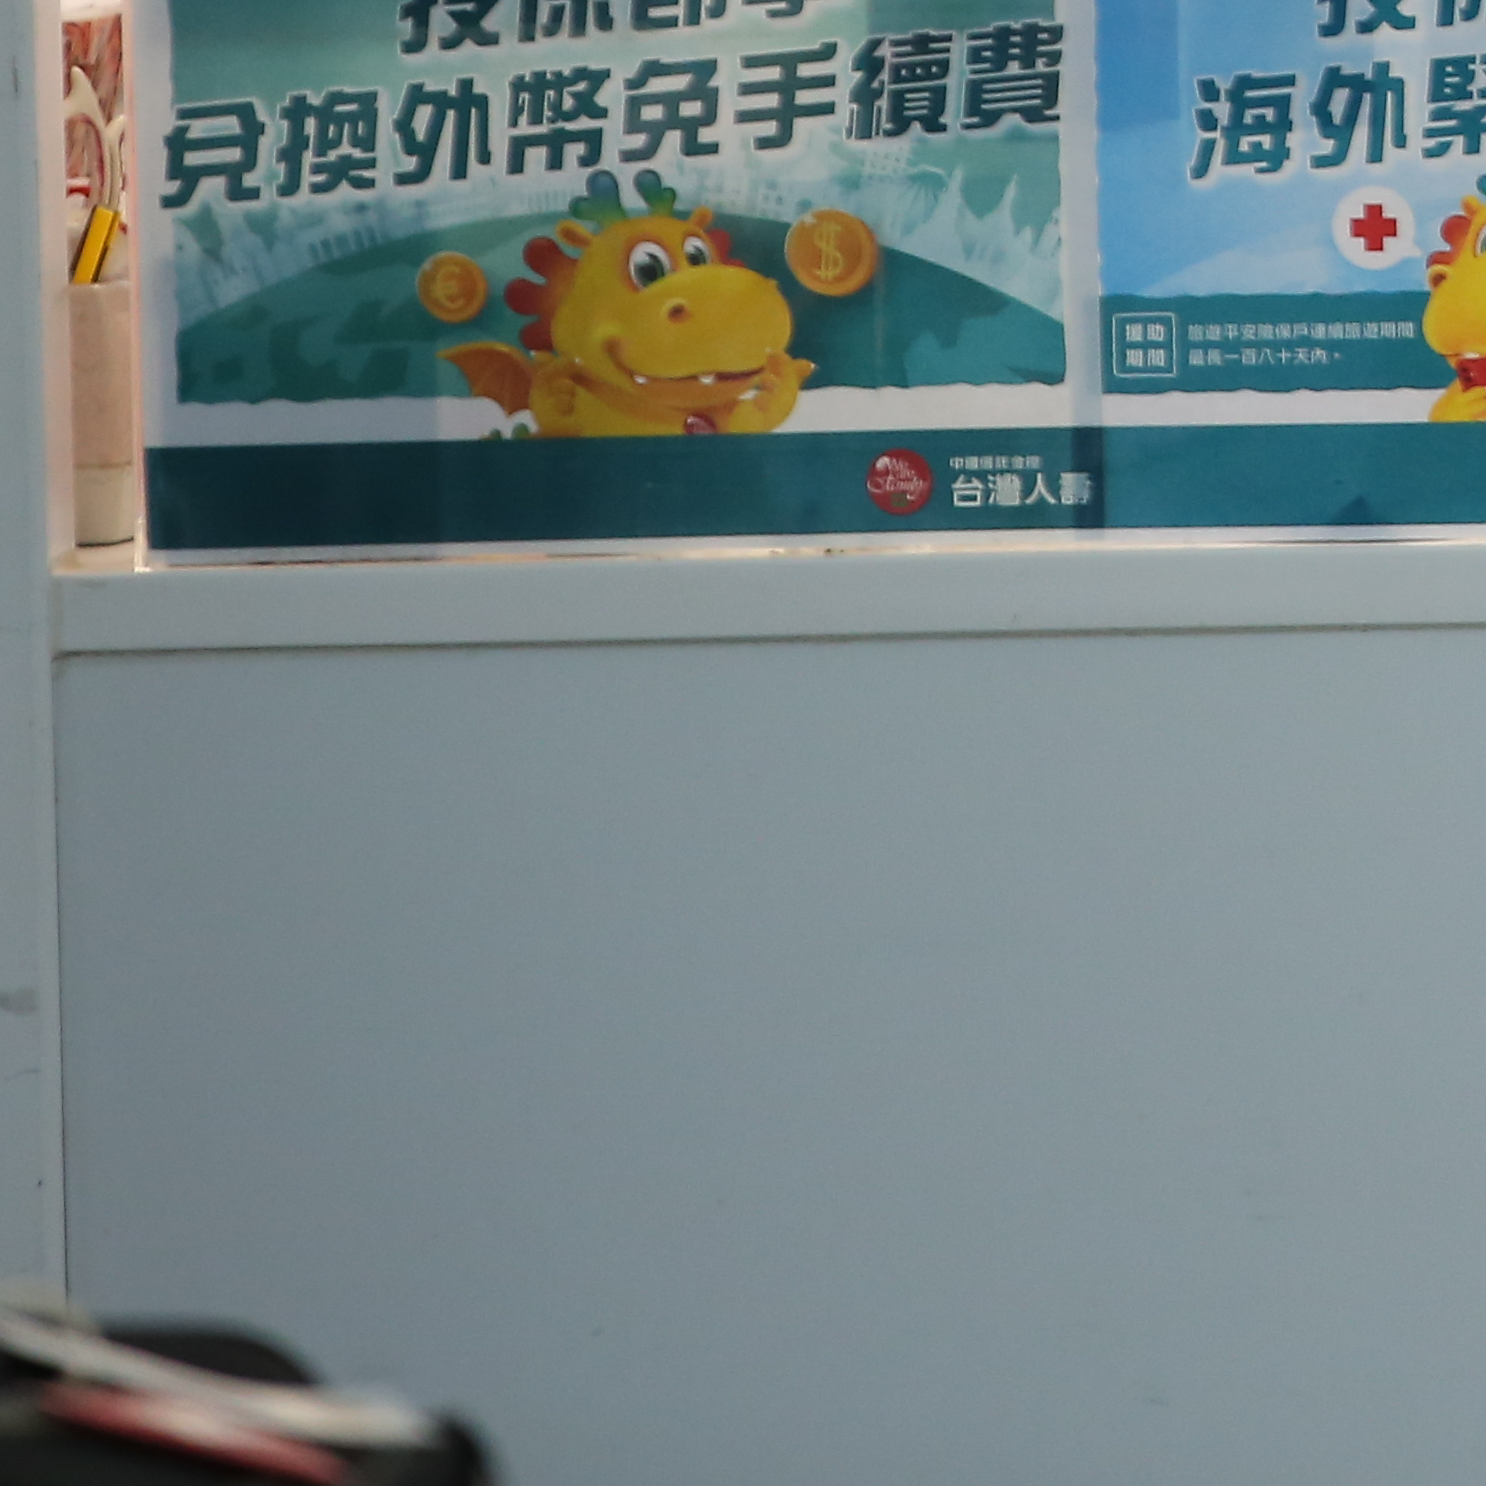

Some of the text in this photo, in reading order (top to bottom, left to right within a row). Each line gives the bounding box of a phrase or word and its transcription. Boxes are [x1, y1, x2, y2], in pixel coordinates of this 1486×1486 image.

[160, 20, 1064, 211] 兌換外幣免手續費
[1126, 322, 1166, 342] 援助
[1126, 347, 1166, 367] 期間
[951, 472, 1093, 507] 台灣人壽
